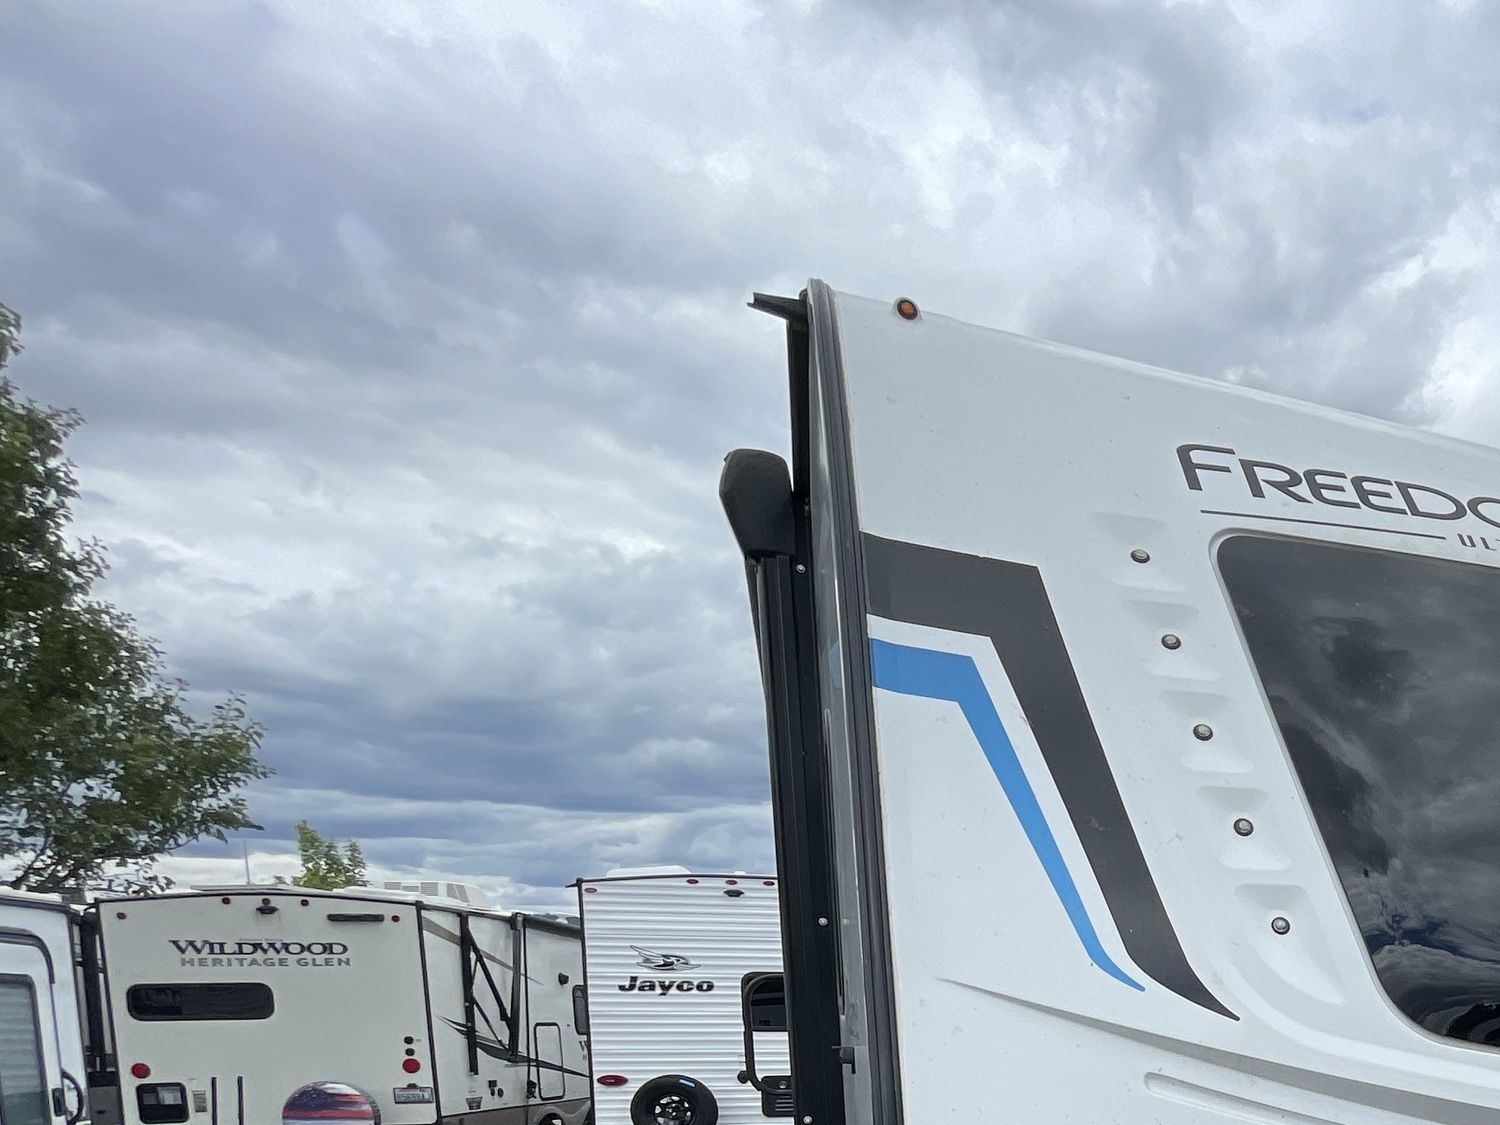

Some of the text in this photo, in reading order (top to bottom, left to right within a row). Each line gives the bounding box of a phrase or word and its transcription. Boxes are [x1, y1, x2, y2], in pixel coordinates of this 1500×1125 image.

[168, 939, 349, 956] WILDWOOD
[180, 957, 352, 968] HERITAGE GLEN
[618, 975, 715, 997] Jayco
